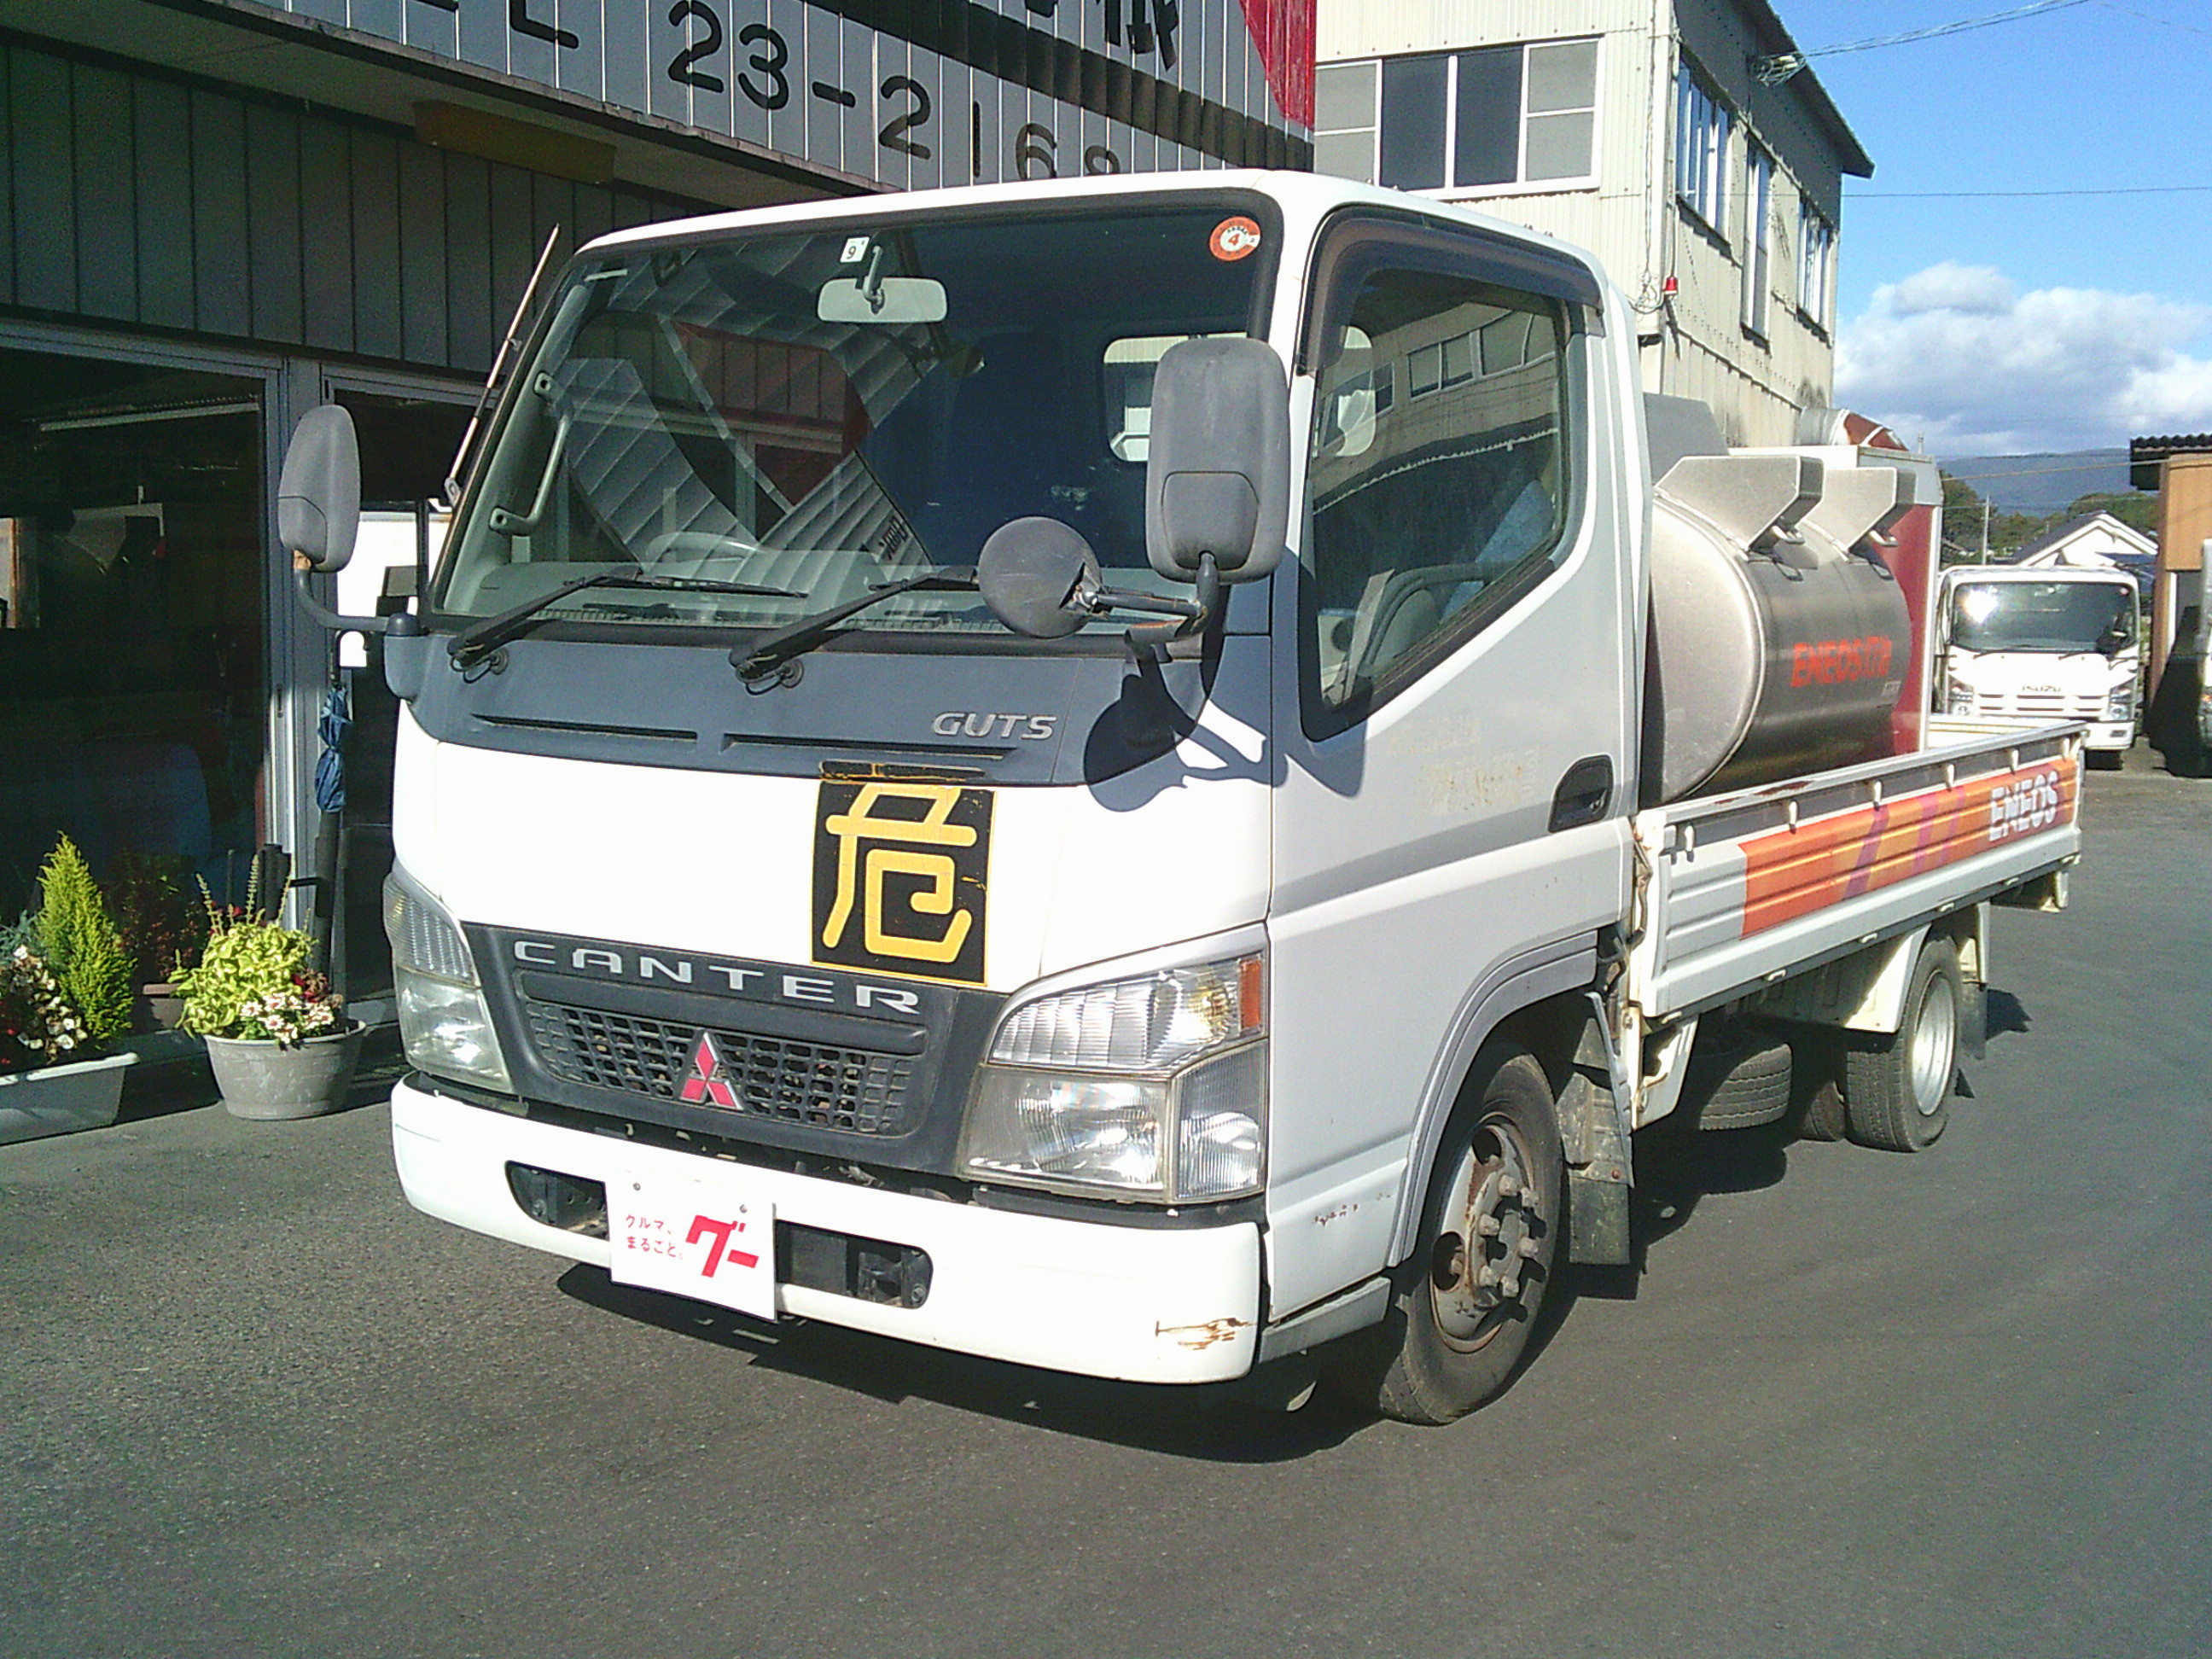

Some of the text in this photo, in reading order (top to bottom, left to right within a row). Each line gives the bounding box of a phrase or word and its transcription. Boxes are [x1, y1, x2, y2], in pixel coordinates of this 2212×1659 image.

[846, 245, 857, 259] 9
[1228, 233, 1241, 246] 4
[931, 712, 1057, 741] GUTS
[1988, 771, 2058, 841] ENEOS
[822, 783, 978, 963] 危
[513, 940, 921, 1016] CANTER
[684, 1214, 760, 1278] グー
